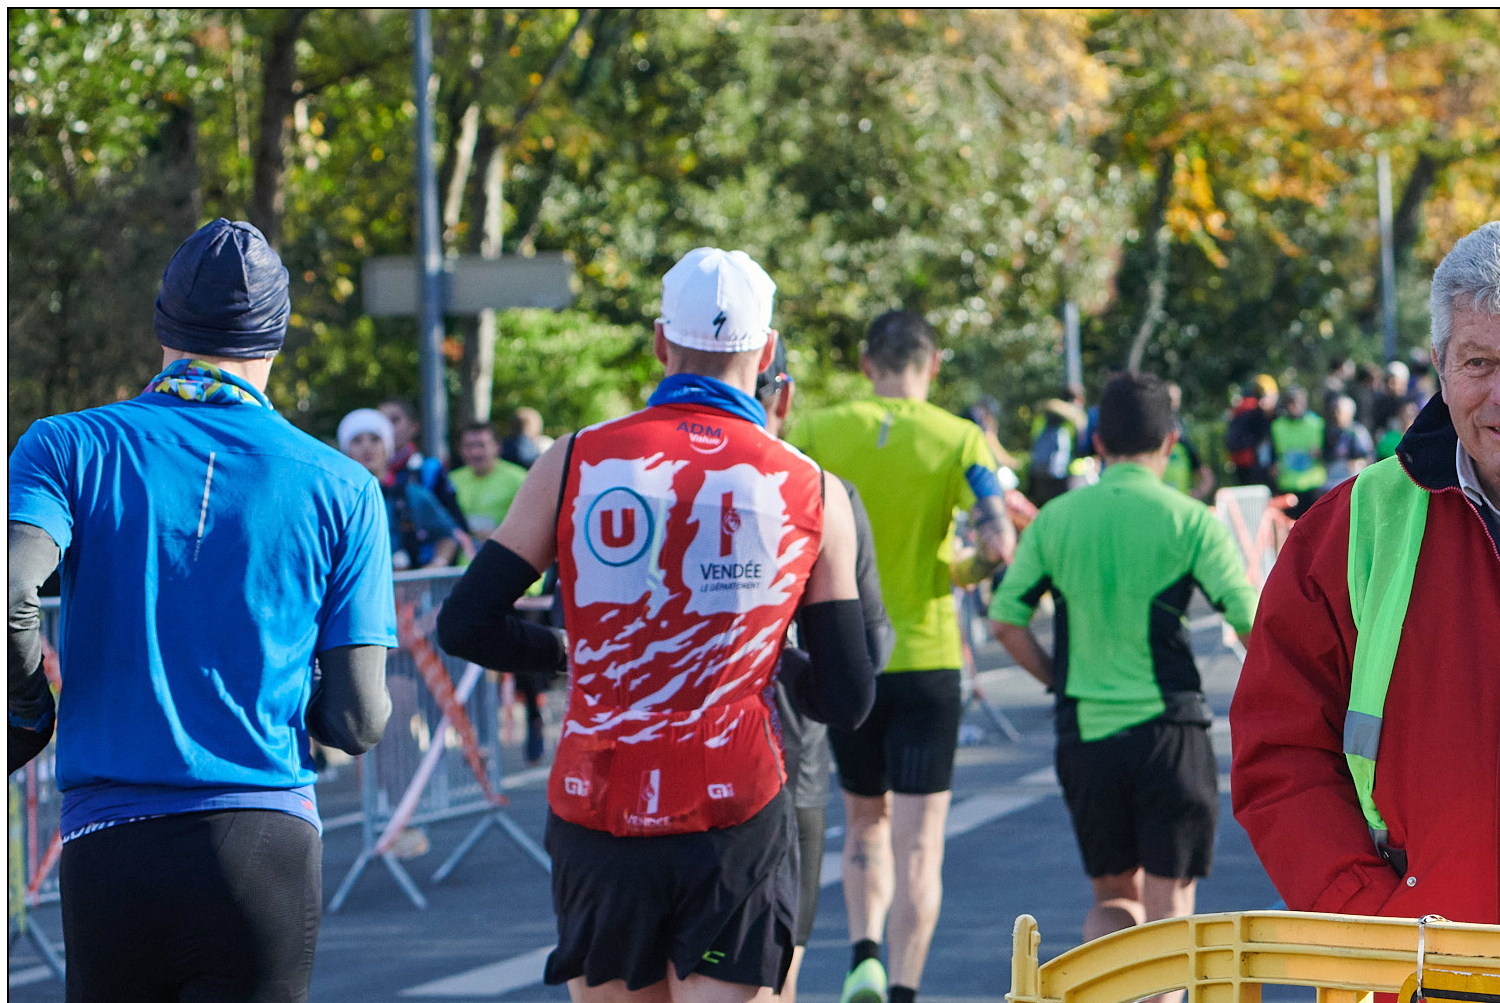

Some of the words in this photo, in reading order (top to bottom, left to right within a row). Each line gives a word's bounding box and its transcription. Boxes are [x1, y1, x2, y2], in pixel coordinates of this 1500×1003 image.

[677, 421, 722, 437] ADM
[601, 508, 635, 548] U
[700, 560, 762, 580] VENDÉE
